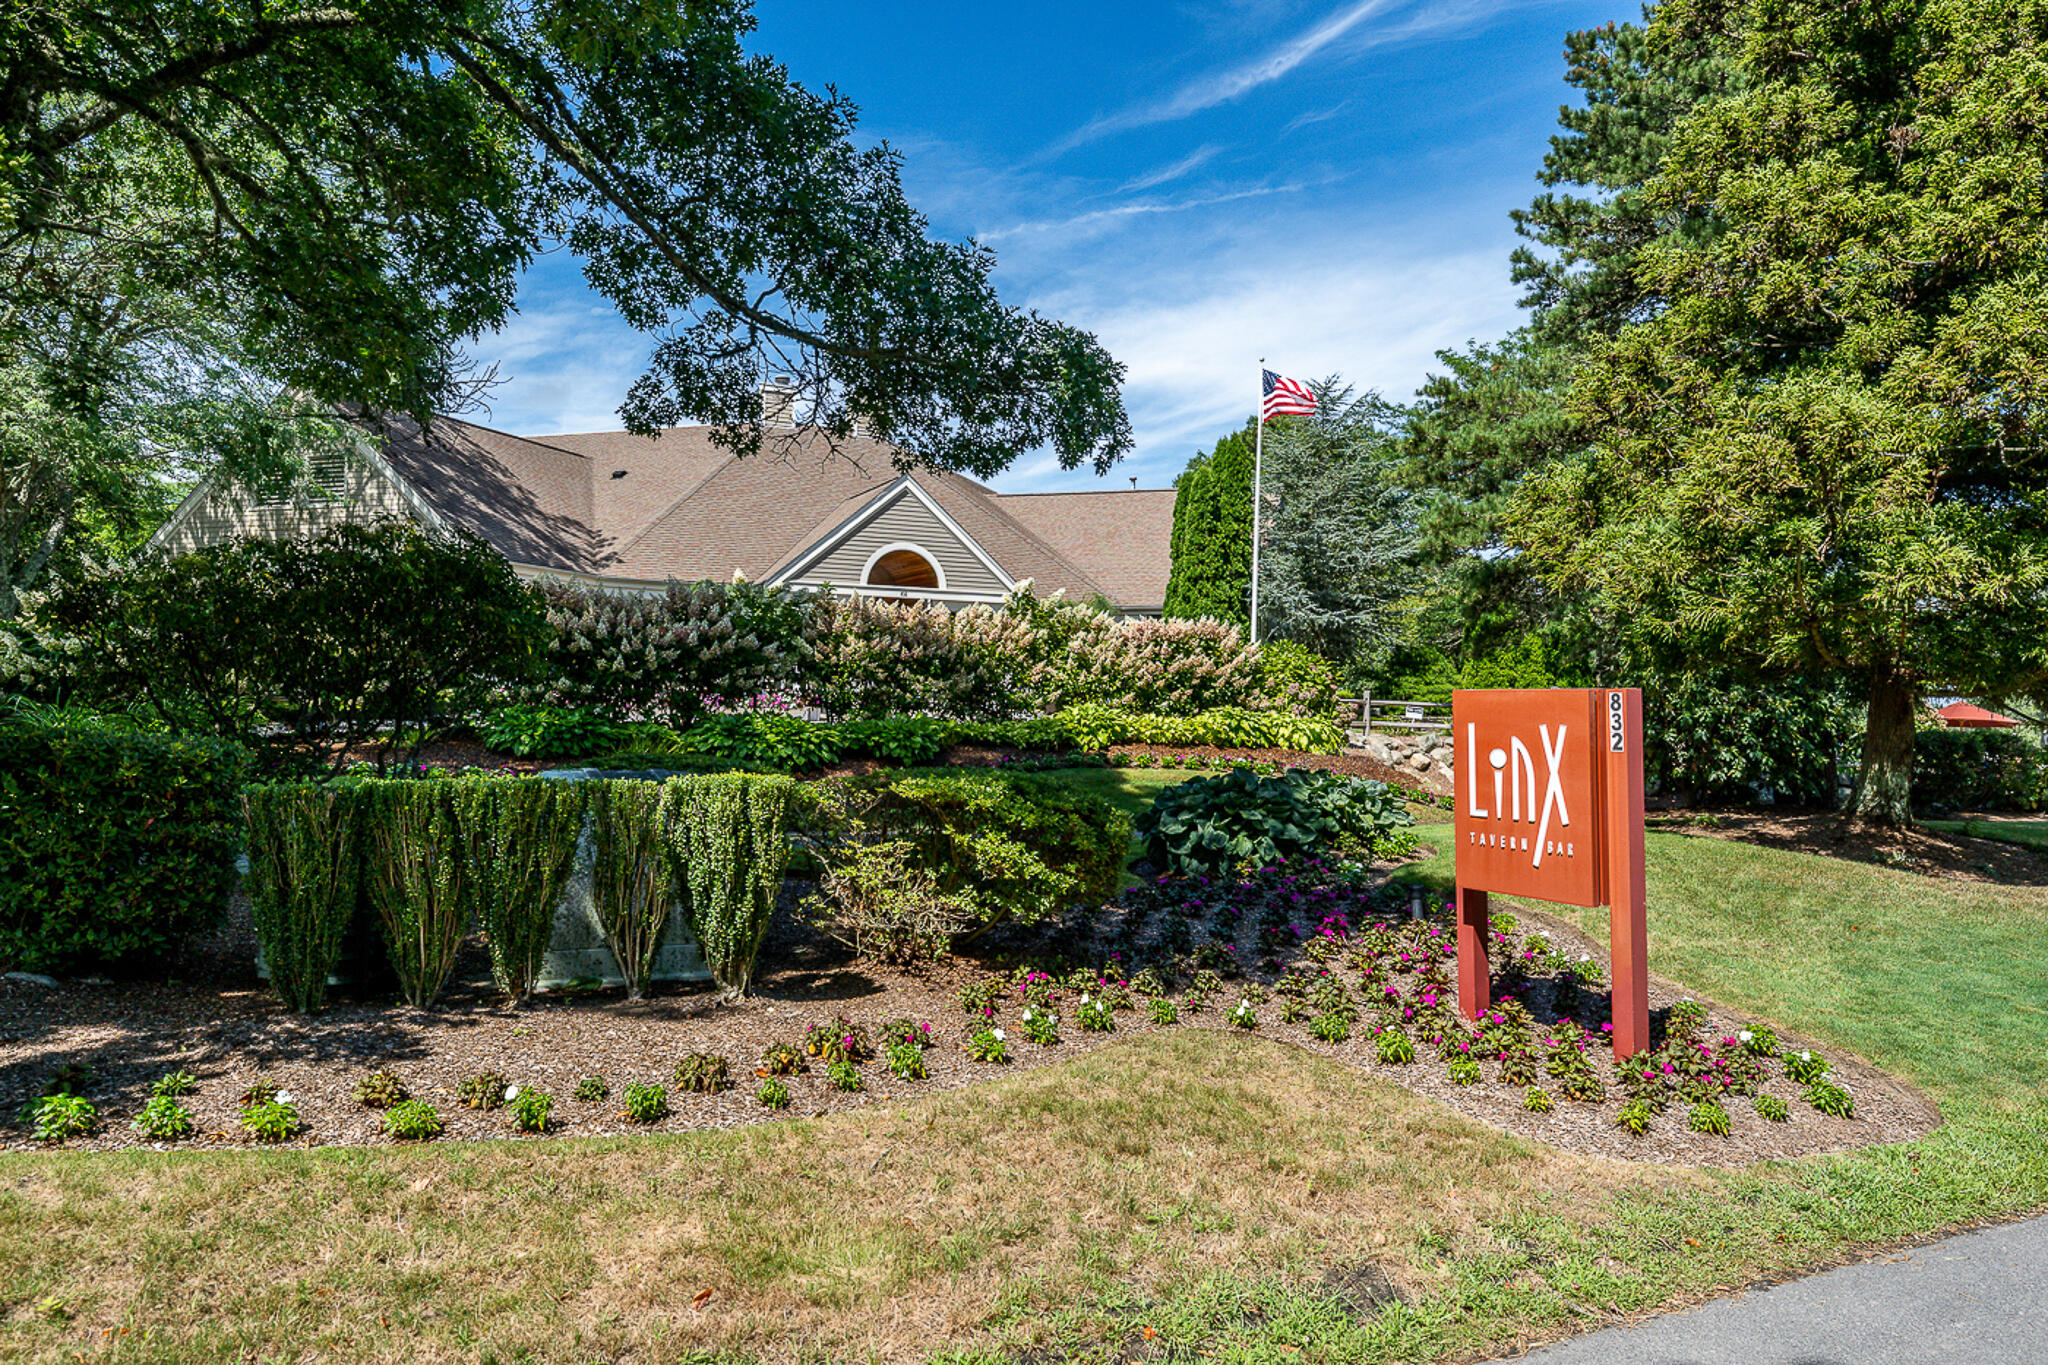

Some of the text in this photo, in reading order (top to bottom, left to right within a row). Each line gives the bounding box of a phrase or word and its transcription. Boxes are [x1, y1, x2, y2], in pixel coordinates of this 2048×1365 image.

[1610, 692, 1623, 751] 832
[1469, 831, 1574, 858] TAVERN BAR
